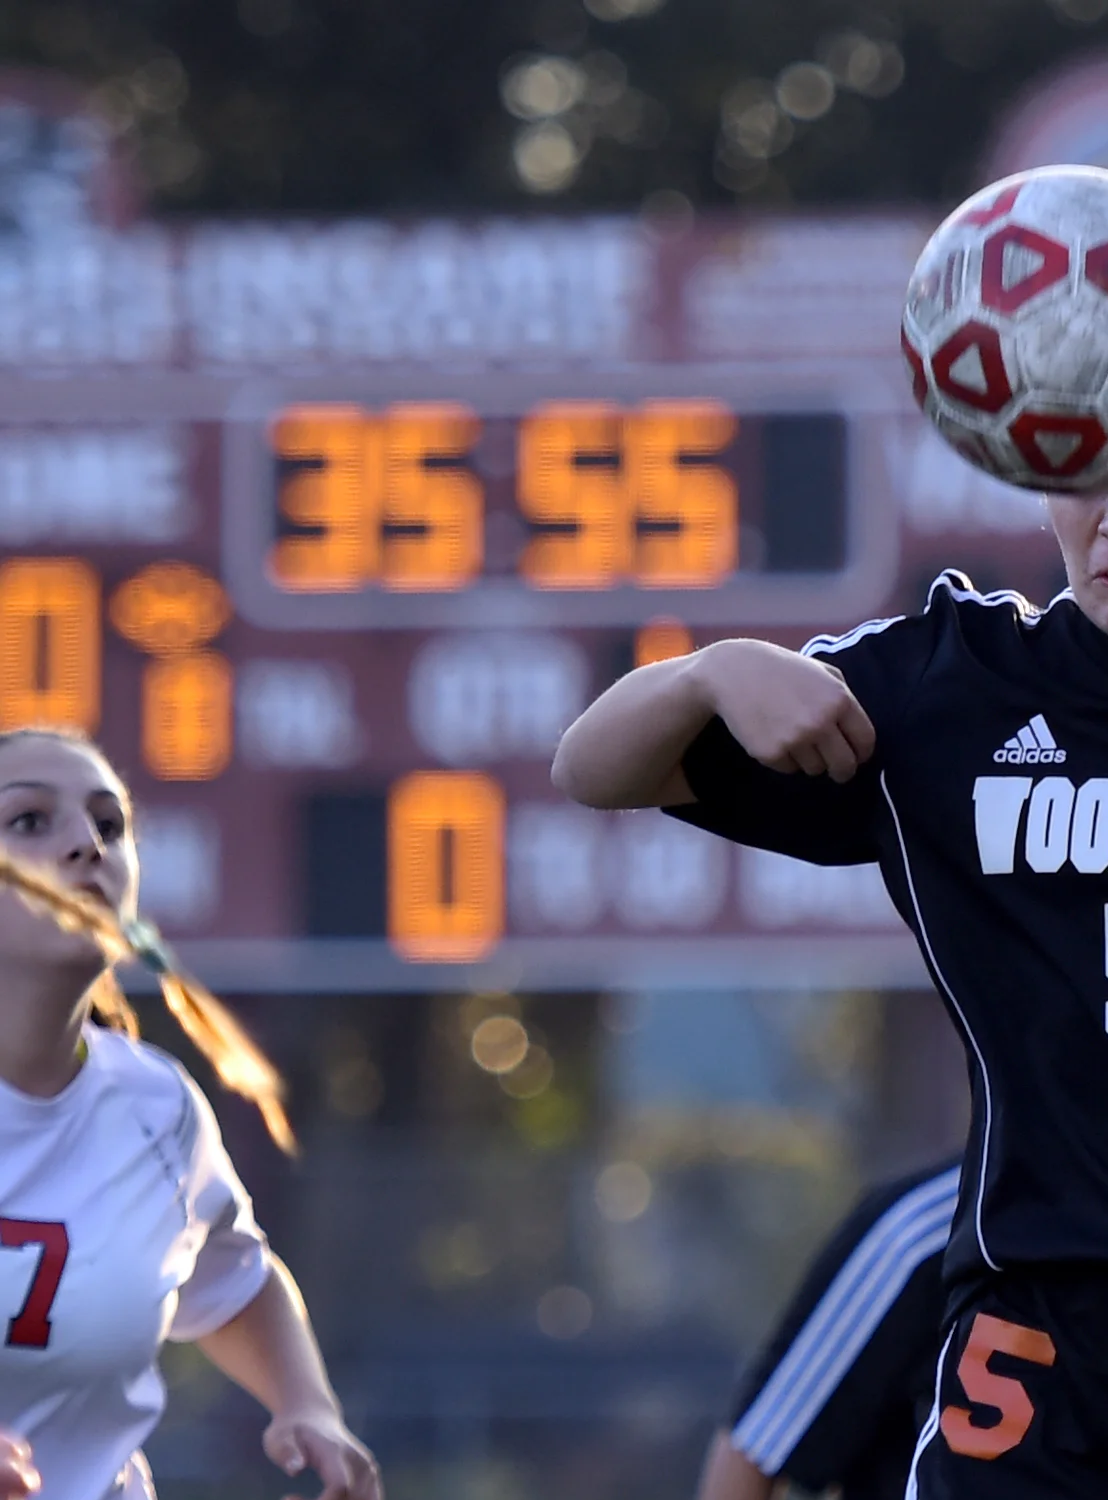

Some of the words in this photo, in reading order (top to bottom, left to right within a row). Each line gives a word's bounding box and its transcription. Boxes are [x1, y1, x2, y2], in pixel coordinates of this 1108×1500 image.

[267, 402, 485, 592] 35
[992, 748, 1067, 765] adidas
[386, 771, 506, 964] 0
[0, 1217, 69, 1349] 7
[940, 1311, 1057, 1461] 5
